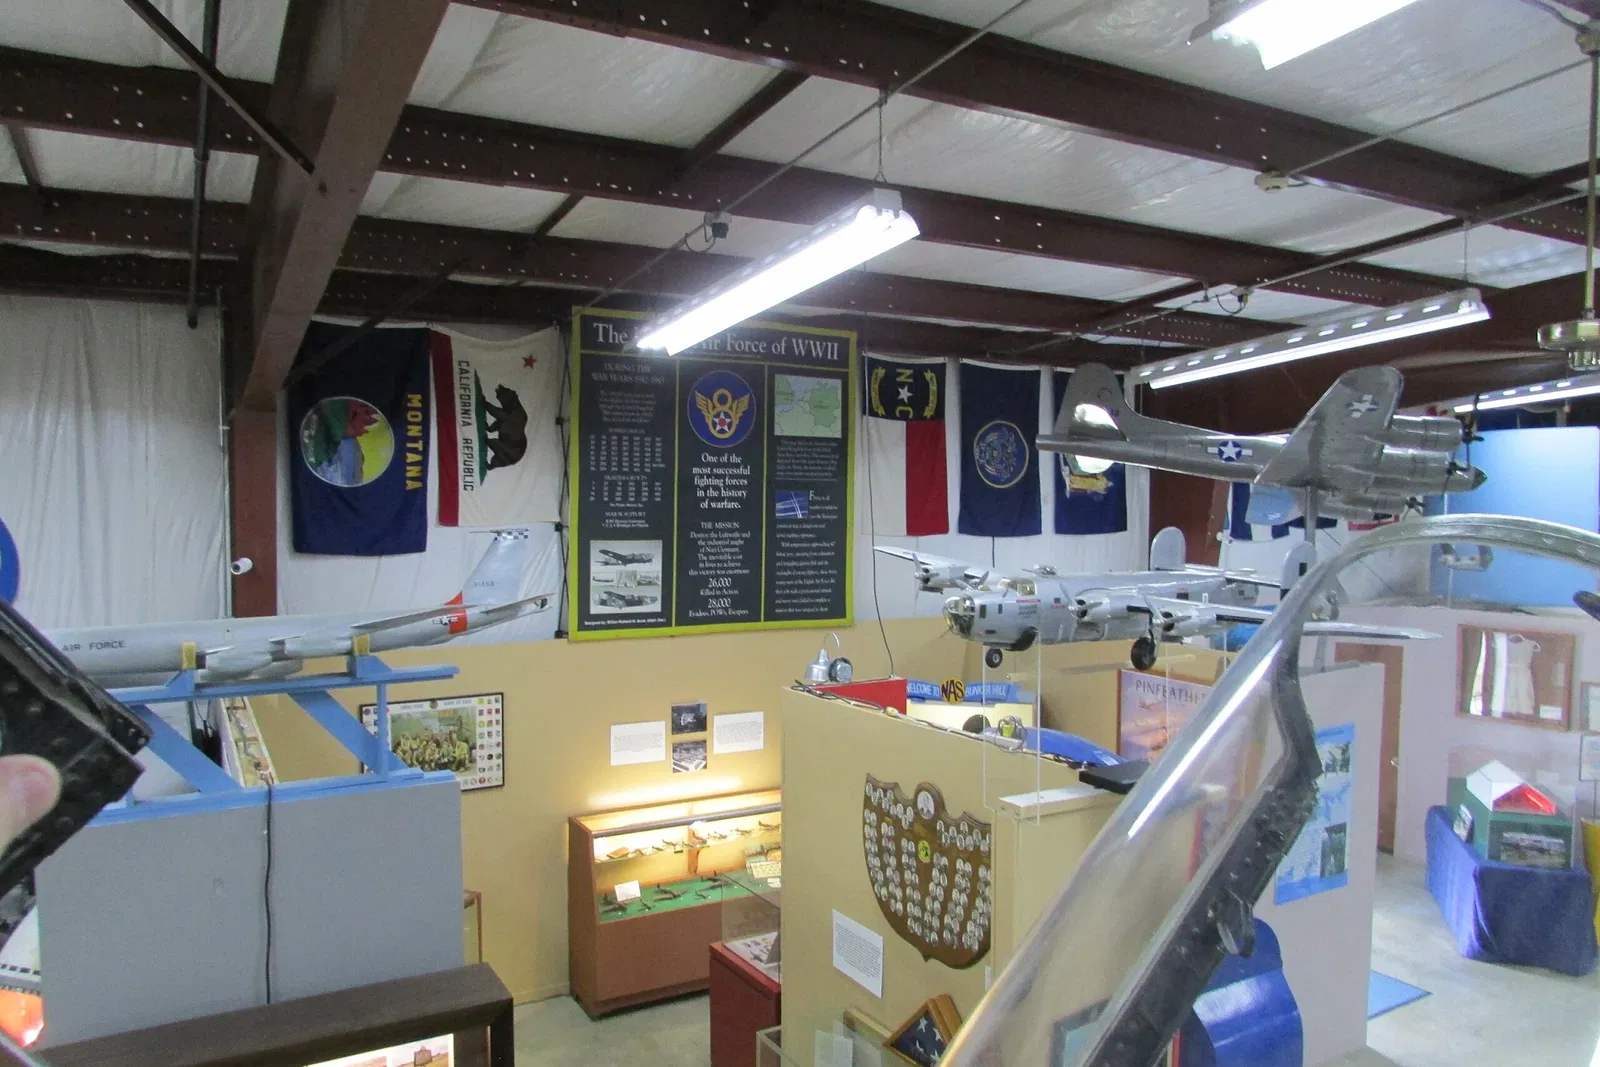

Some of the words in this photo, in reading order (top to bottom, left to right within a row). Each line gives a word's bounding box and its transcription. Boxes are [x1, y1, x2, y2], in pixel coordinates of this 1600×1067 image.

[593, 322, 628, 344] The
[725, 333, 767, 355] Force
[771, 337, 788, 355] of
[791, 339, 839, 360] WWII
[896, 368, 914, 382] N
[458, 360, 472, 427] CALIFORNIA
[895, 406, 914, 418] C
[406, 394, 423, 490] MONTANA
[701, 452, 719, 463] One
[720, 452, 728, 463] of
[730, 453, 742, 463] the
[462, 438, 474, 492] REPUBLIC
[713, 464, 751, 475] successful
[694, 475, 724, 487] fighting
[725, 475, 748, 486] forces
[696, 487, 705, 497] in
[707, 487, 720, 497] the
[721, 487, 747, 499] history
[700, 498, 709, 509] of
[711, 498, 741, 509] warfare.
[701, 521, 713, 529] THE
[714, 521, 740, 529] MISSION
[708, 577, 732, 588] 26,000
[700, 588, 715, 596] Killed
[707, 597, 731, 609] 28,000
[62, 643, 81, 652] AIR
[89, 640, 125, 650] FORCE
[932, 686, 940, 697] TO
[941, 679, 964, 702] NAS
